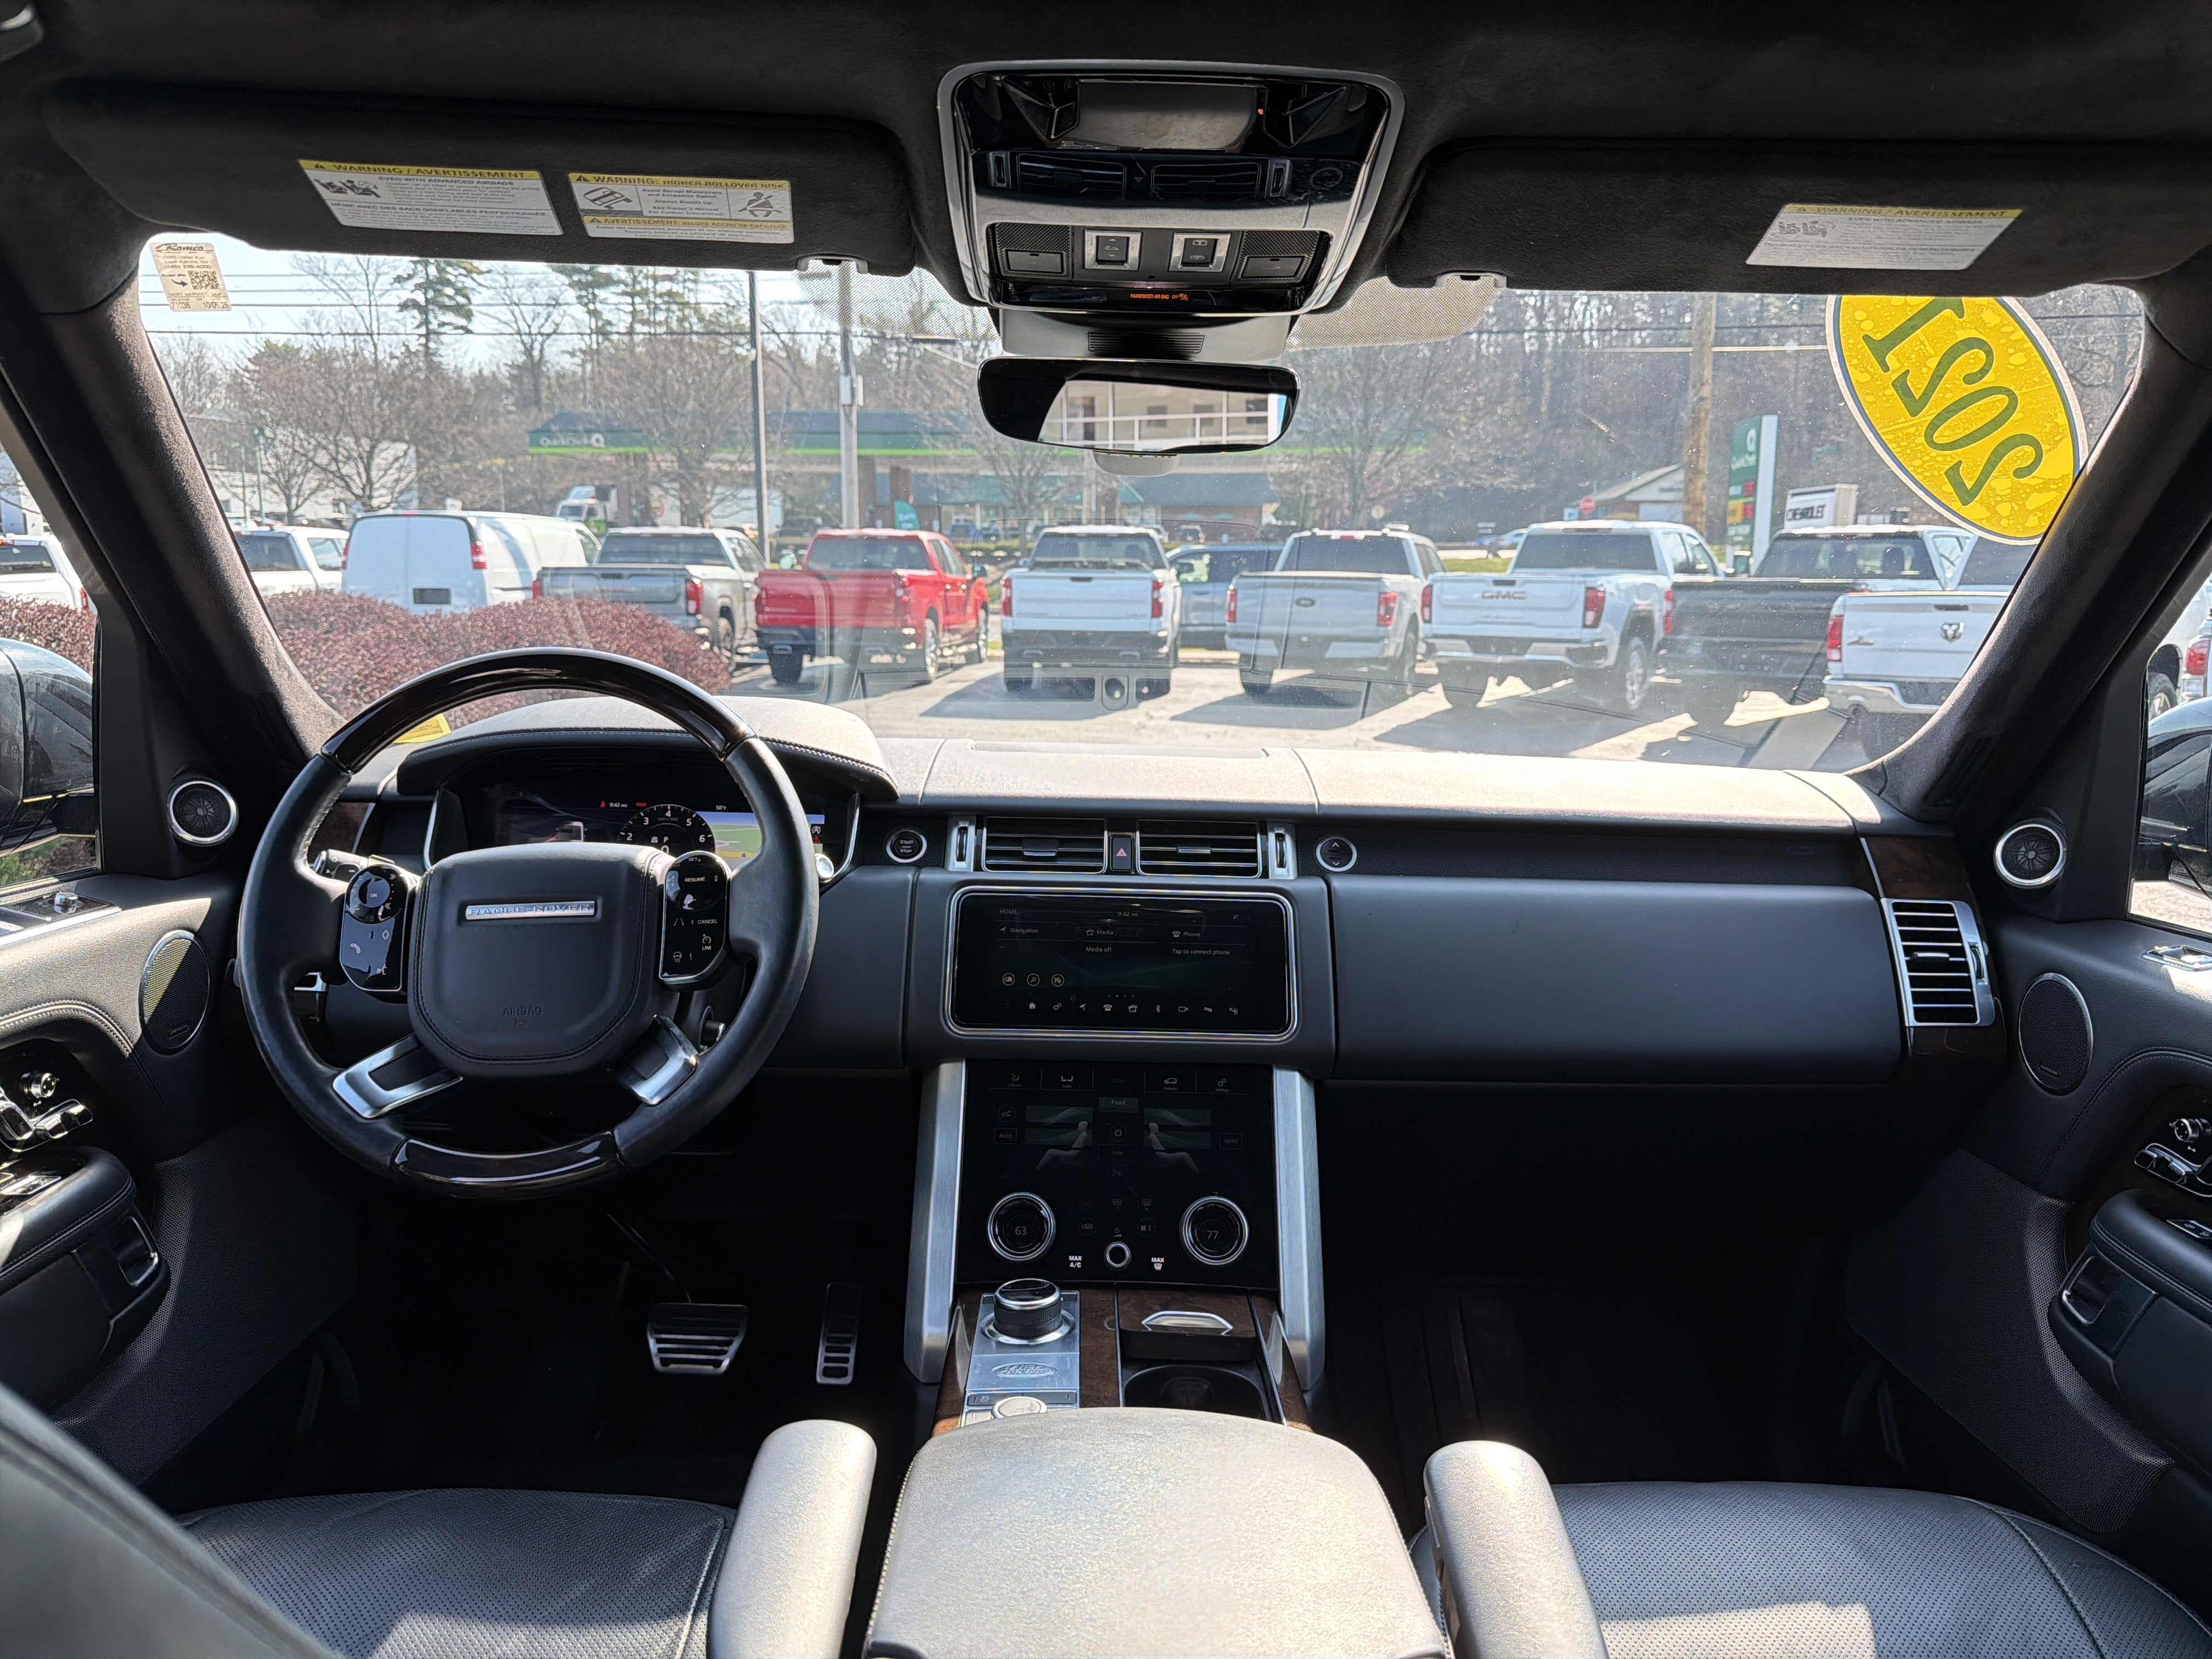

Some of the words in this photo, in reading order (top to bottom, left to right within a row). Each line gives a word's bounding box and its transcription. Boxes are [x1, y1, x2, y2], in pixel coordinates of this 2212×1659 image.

[334, 165, 402, 173] WARNING
[416, 168, 525, 178] AVERTISSEMENT
[592, 176, 659, 185] WARNING:
[1893, 209, 2006, 217] AVERTISSEMENT
[604, 218, 680, 226] AVERTISSEMENT:
[1481, 590, 1527, 600] GMC
[643, 817, 650, 825] 3
[686, 818, 692, 826] 5
[626, 832, 633, 841] 2
[699, 834, 706, 843] 6
[469, 906, 527, 916] RANGE
[533, 903, 591, 913] ROVER
[503, 1006, 544, 1017] AIRBAG
[1015, 1226, 1027, 1235] 63
[1206, 1231, 1219, 1240] 77
